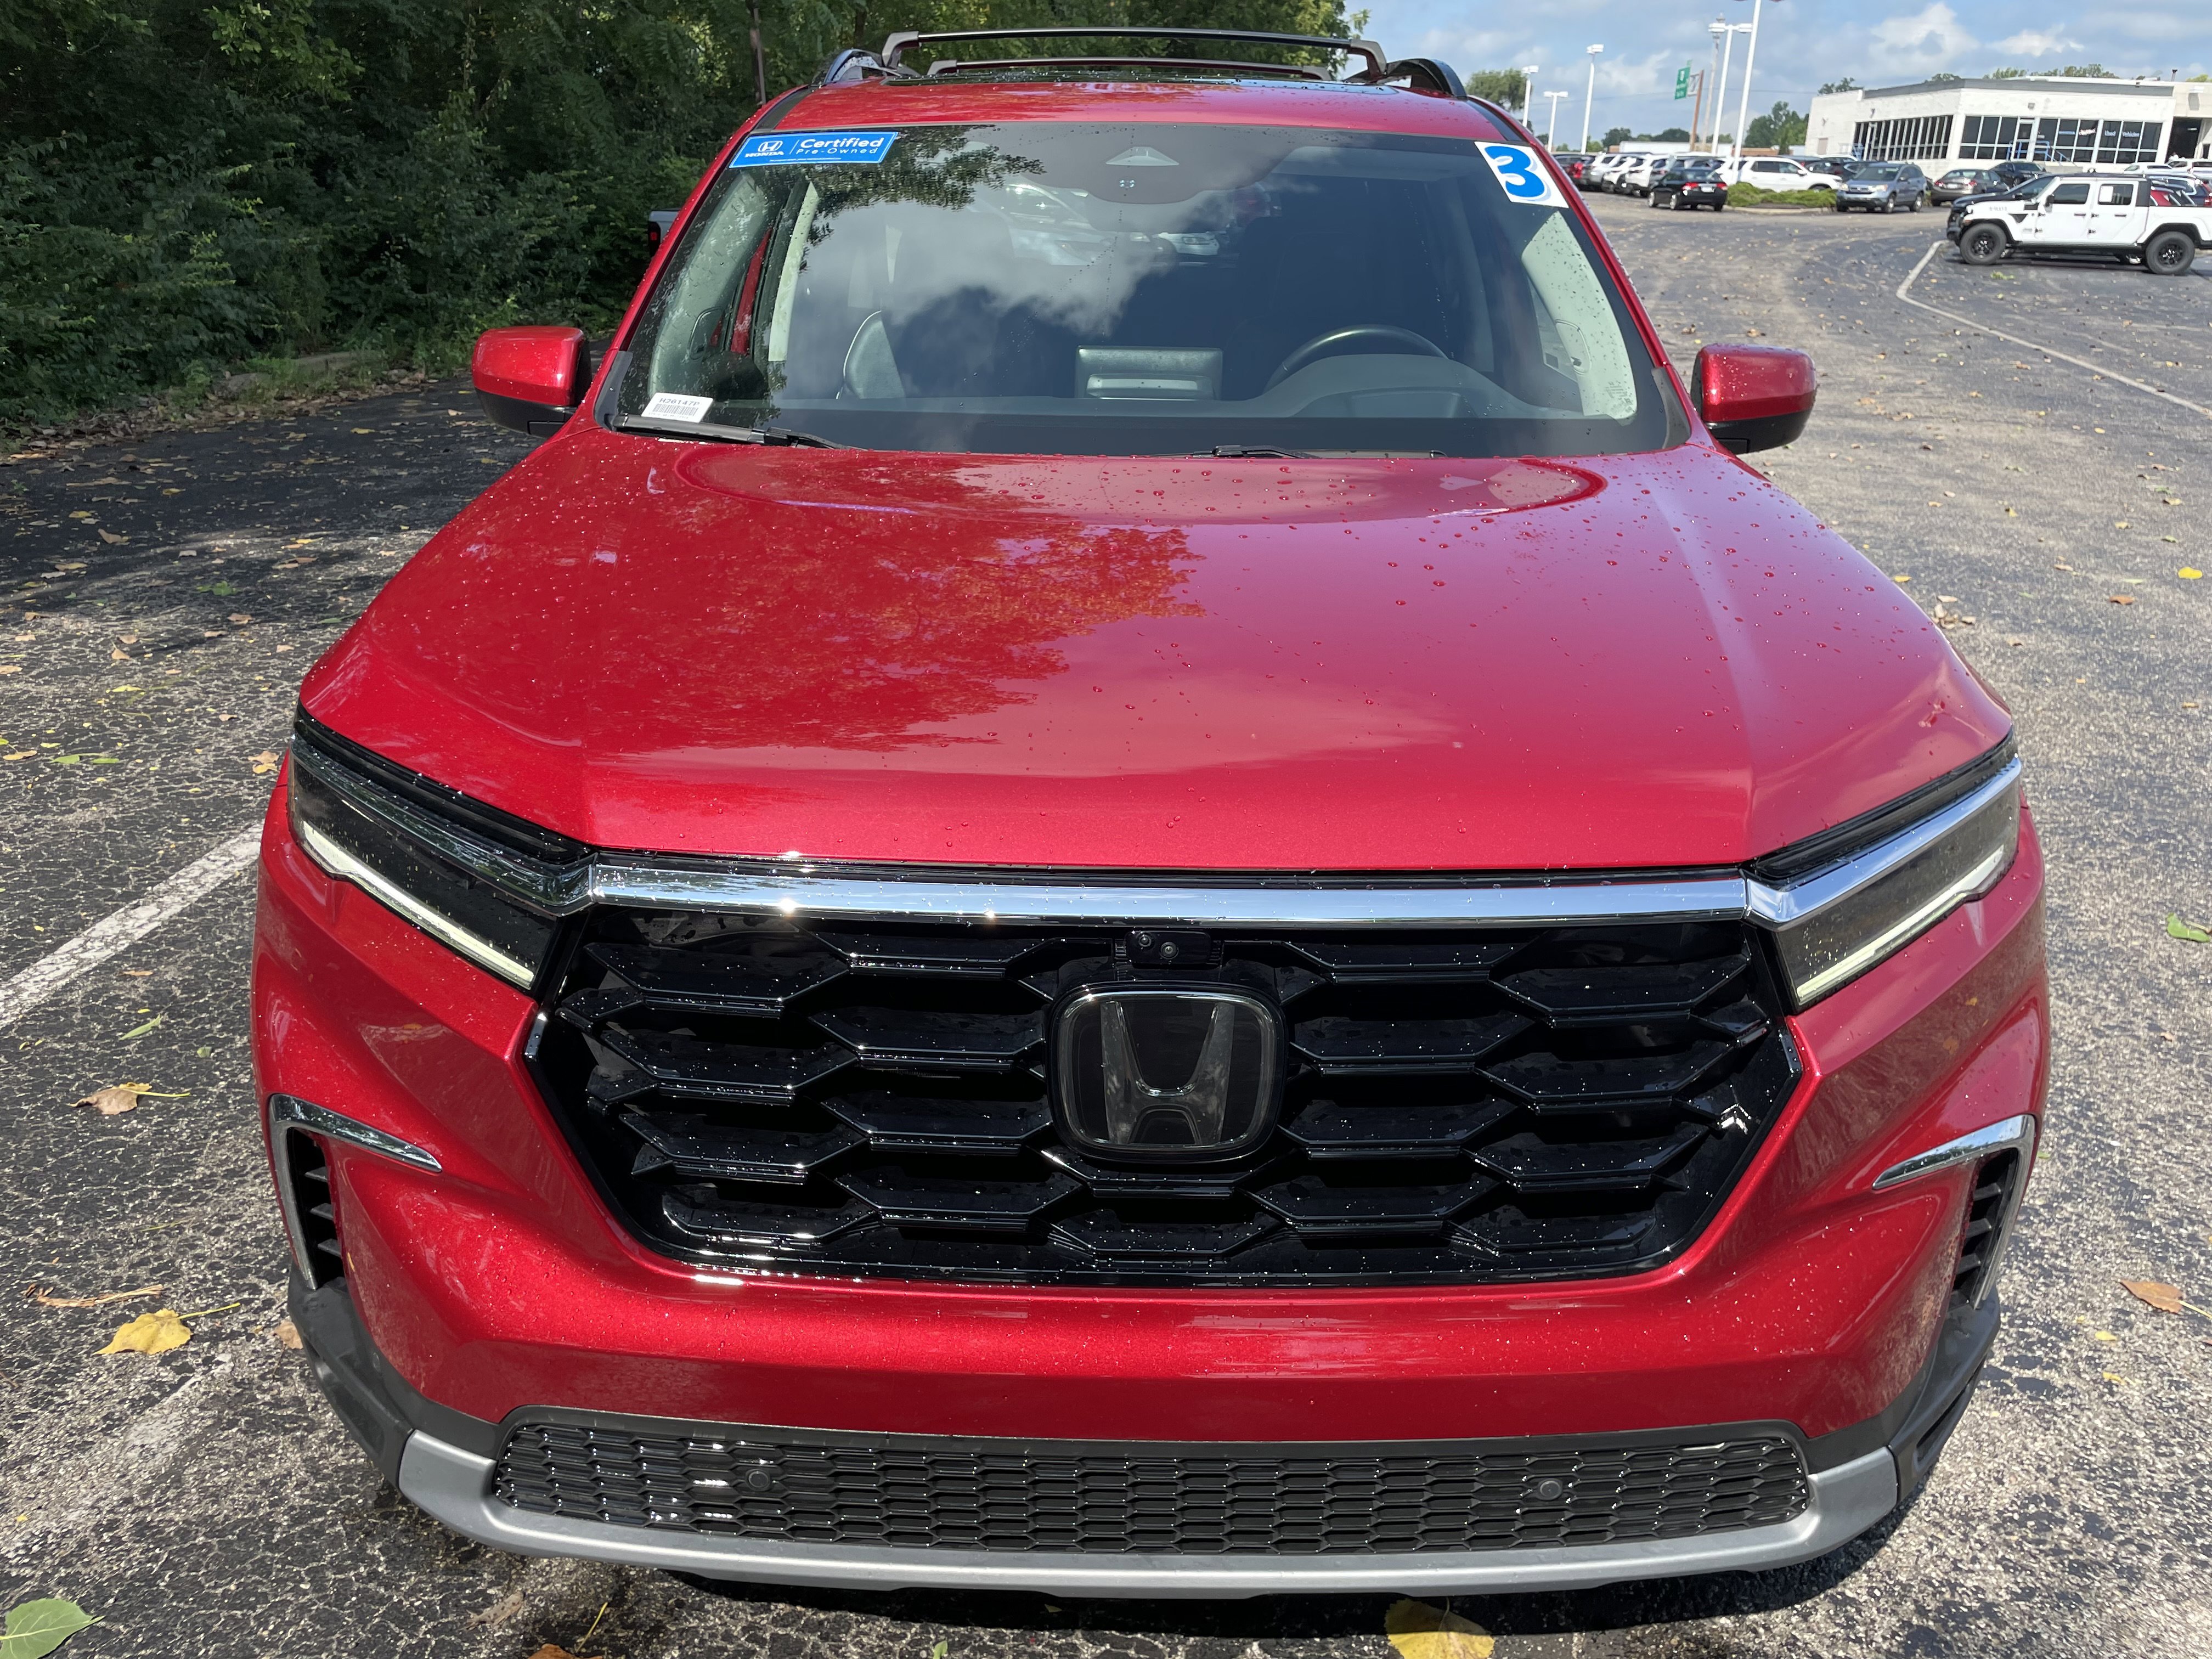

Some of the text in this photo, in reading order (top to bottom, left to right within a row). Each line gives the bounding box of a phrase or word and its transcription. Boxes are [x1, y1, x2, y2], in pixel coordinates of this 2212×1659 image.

[800, 137, 885, 148] Certified
[1485, 145, 1545, 198] 3
[659, 398, 701, 407] H26147P
